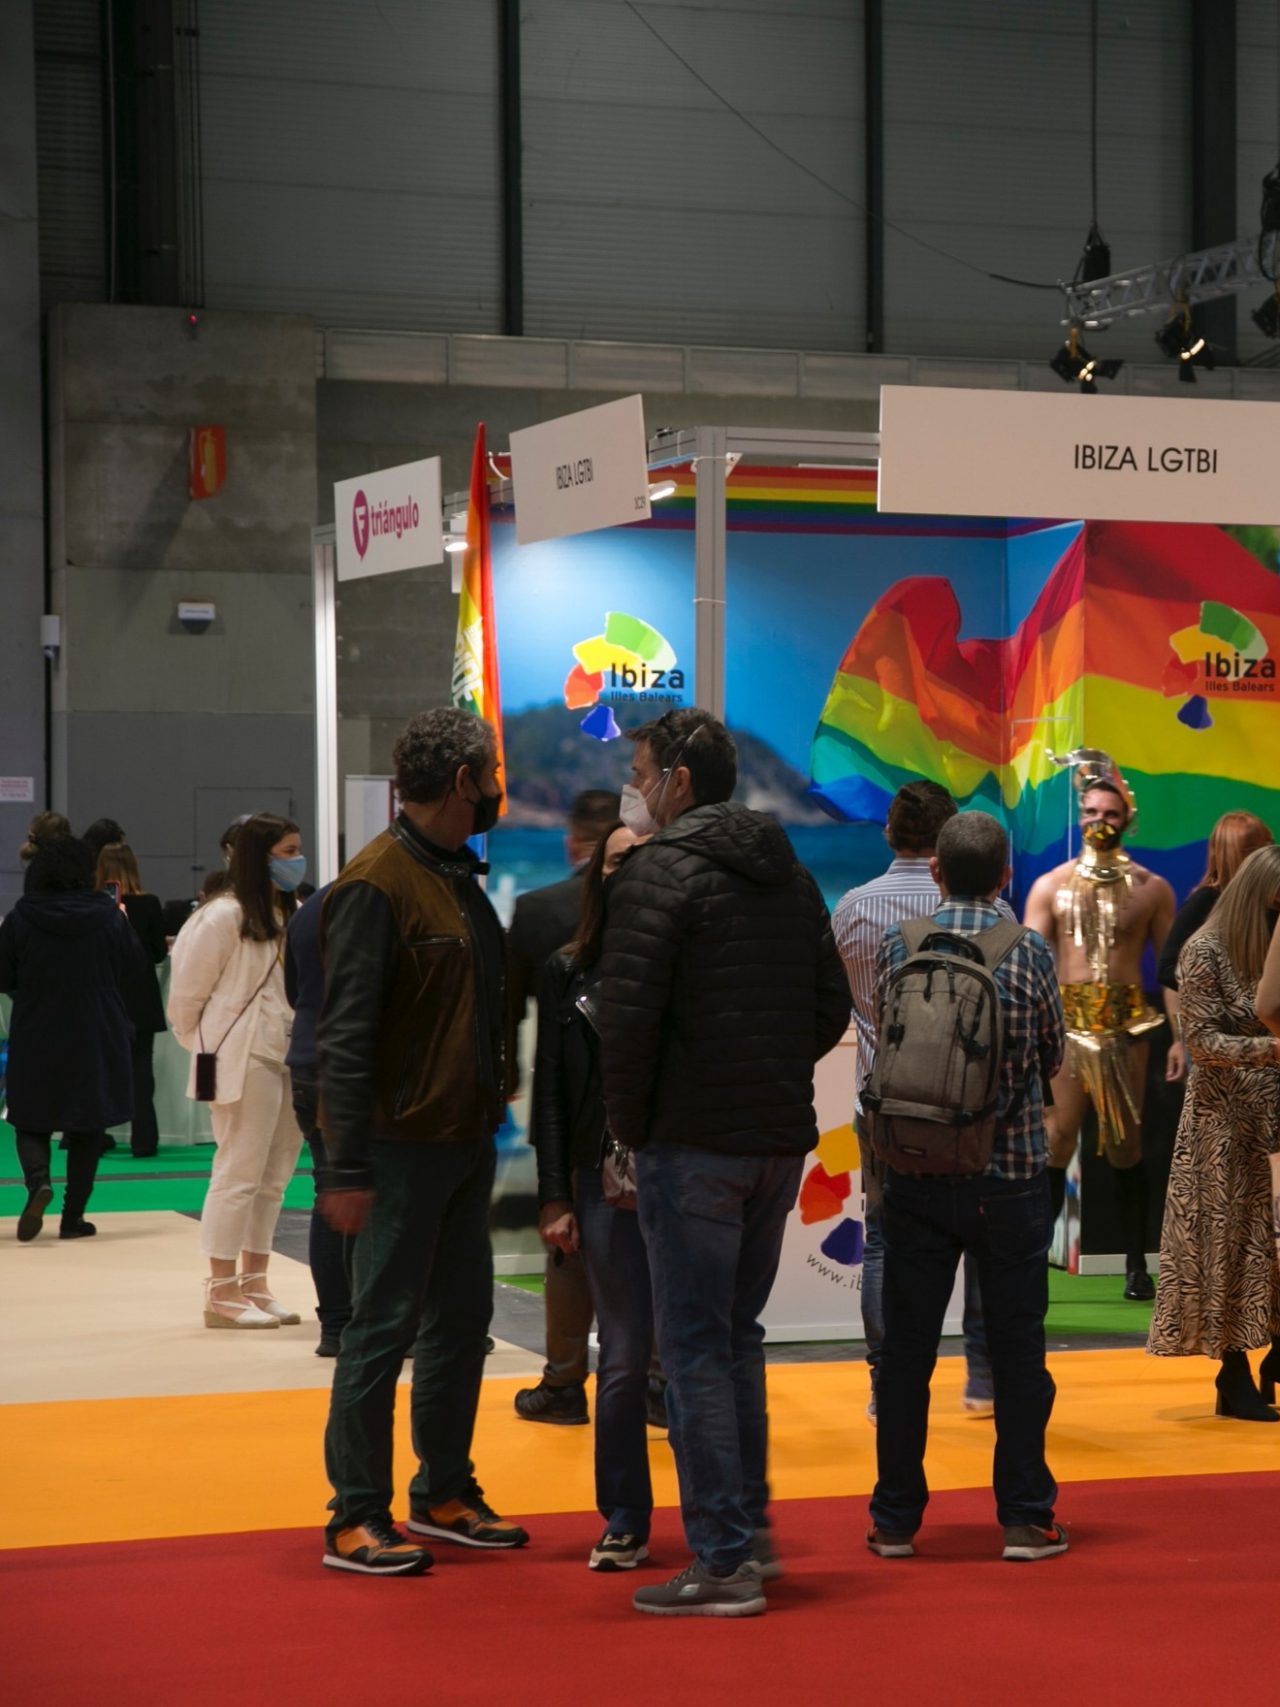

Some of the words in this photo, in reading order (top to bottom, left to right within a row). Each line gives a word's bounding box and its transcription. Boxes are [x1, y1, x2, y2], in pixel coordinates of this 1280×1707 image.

[1073, 443, 1138, 472] IBIZA
[1147, 446, 1218, 474] LGTBI
[556, 463, 573, 490] IBIZA
[575, 457, 594, 485] LGTBI
[370, 494, 420, 539] triángulo
[609, 662, 685, 689] Ibiza
[1204, 651, 1276, 679] Ibiza
[639, 690, 684, 702] Balears
[1232, 680, 1276, 693] Balears
